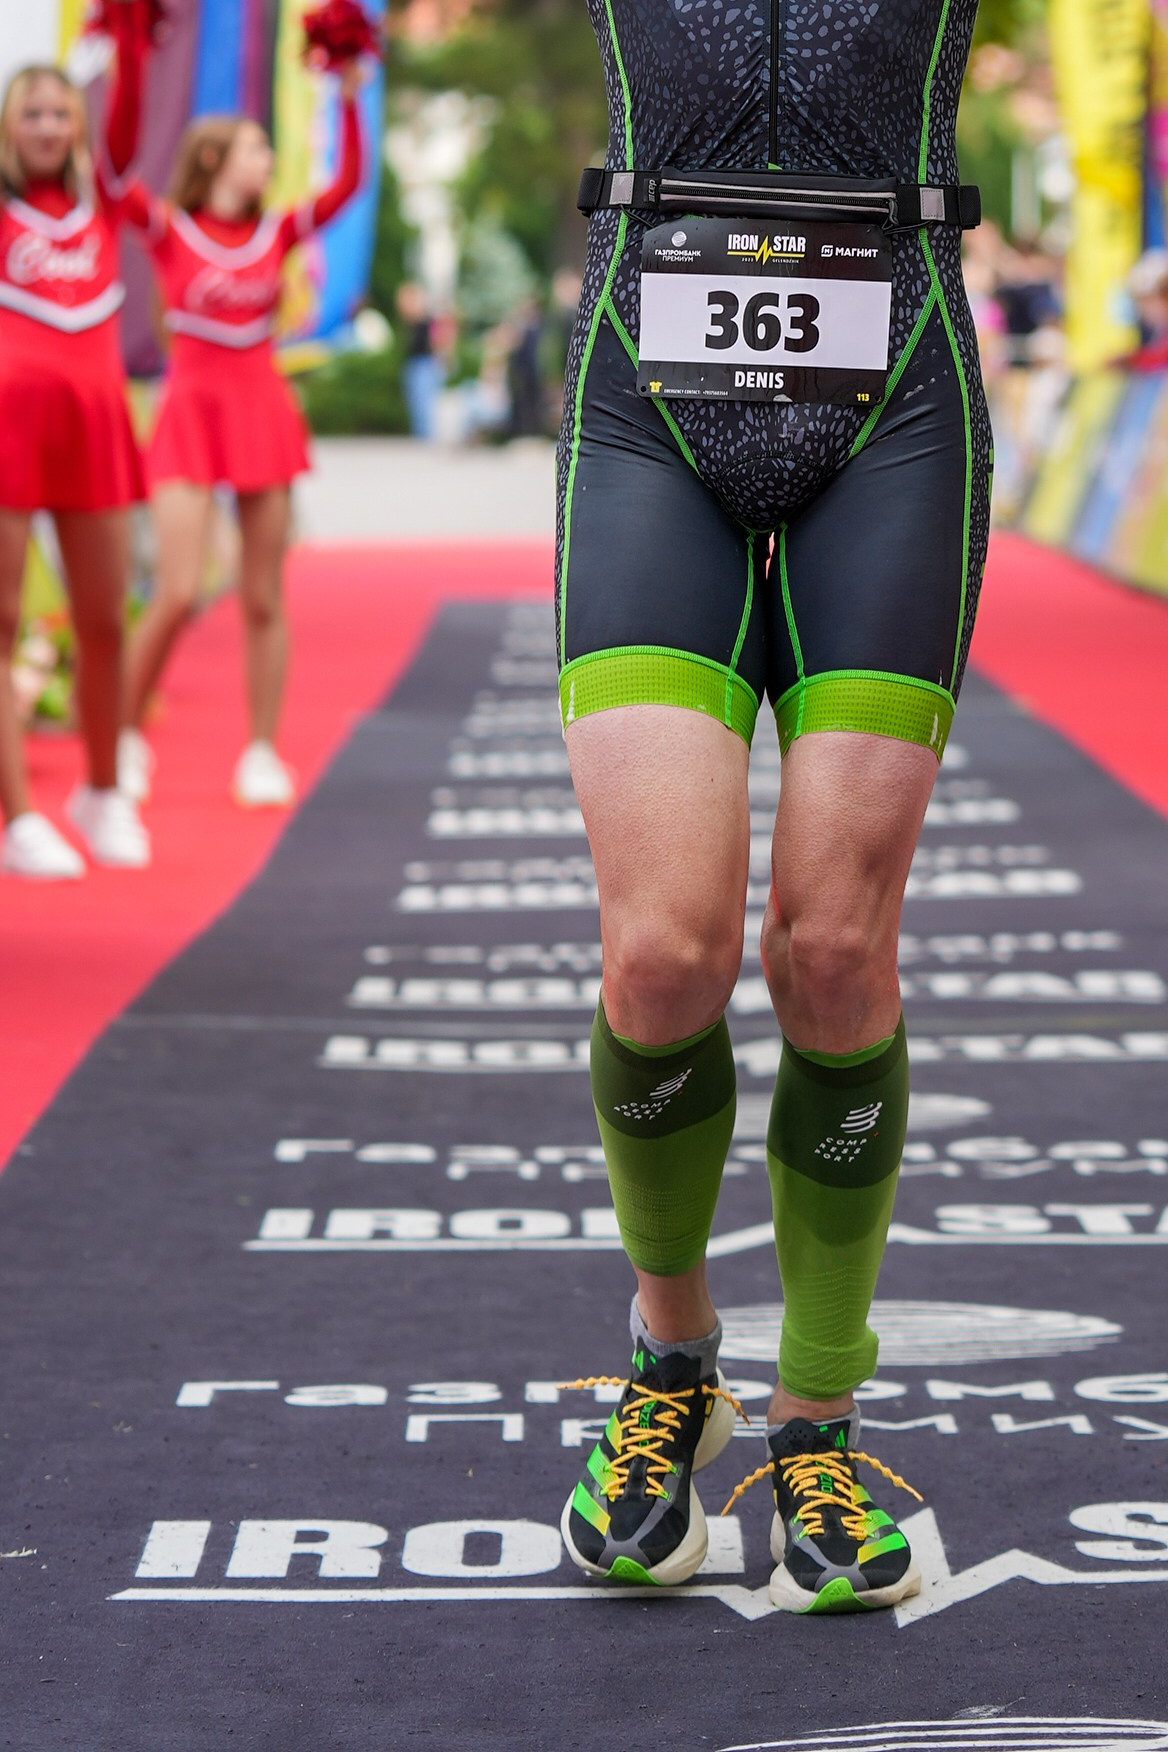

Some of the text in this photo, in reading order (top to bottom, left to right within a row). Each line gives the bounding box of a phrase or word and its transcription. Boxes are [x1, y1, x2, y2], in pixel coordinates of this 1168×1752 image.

[728, 234, 807, 252] IRON STAR
[655, 249, 701, 257] ГАЗПРОМБАНК
[835, 247, 879, 258] МАГНИТ
[704, 290, 821, 354] 363
[734, 371, 785, 389] DENIS
[856, 393, 870, 402] 113
[260, 1208, 618, 1240] IRO
